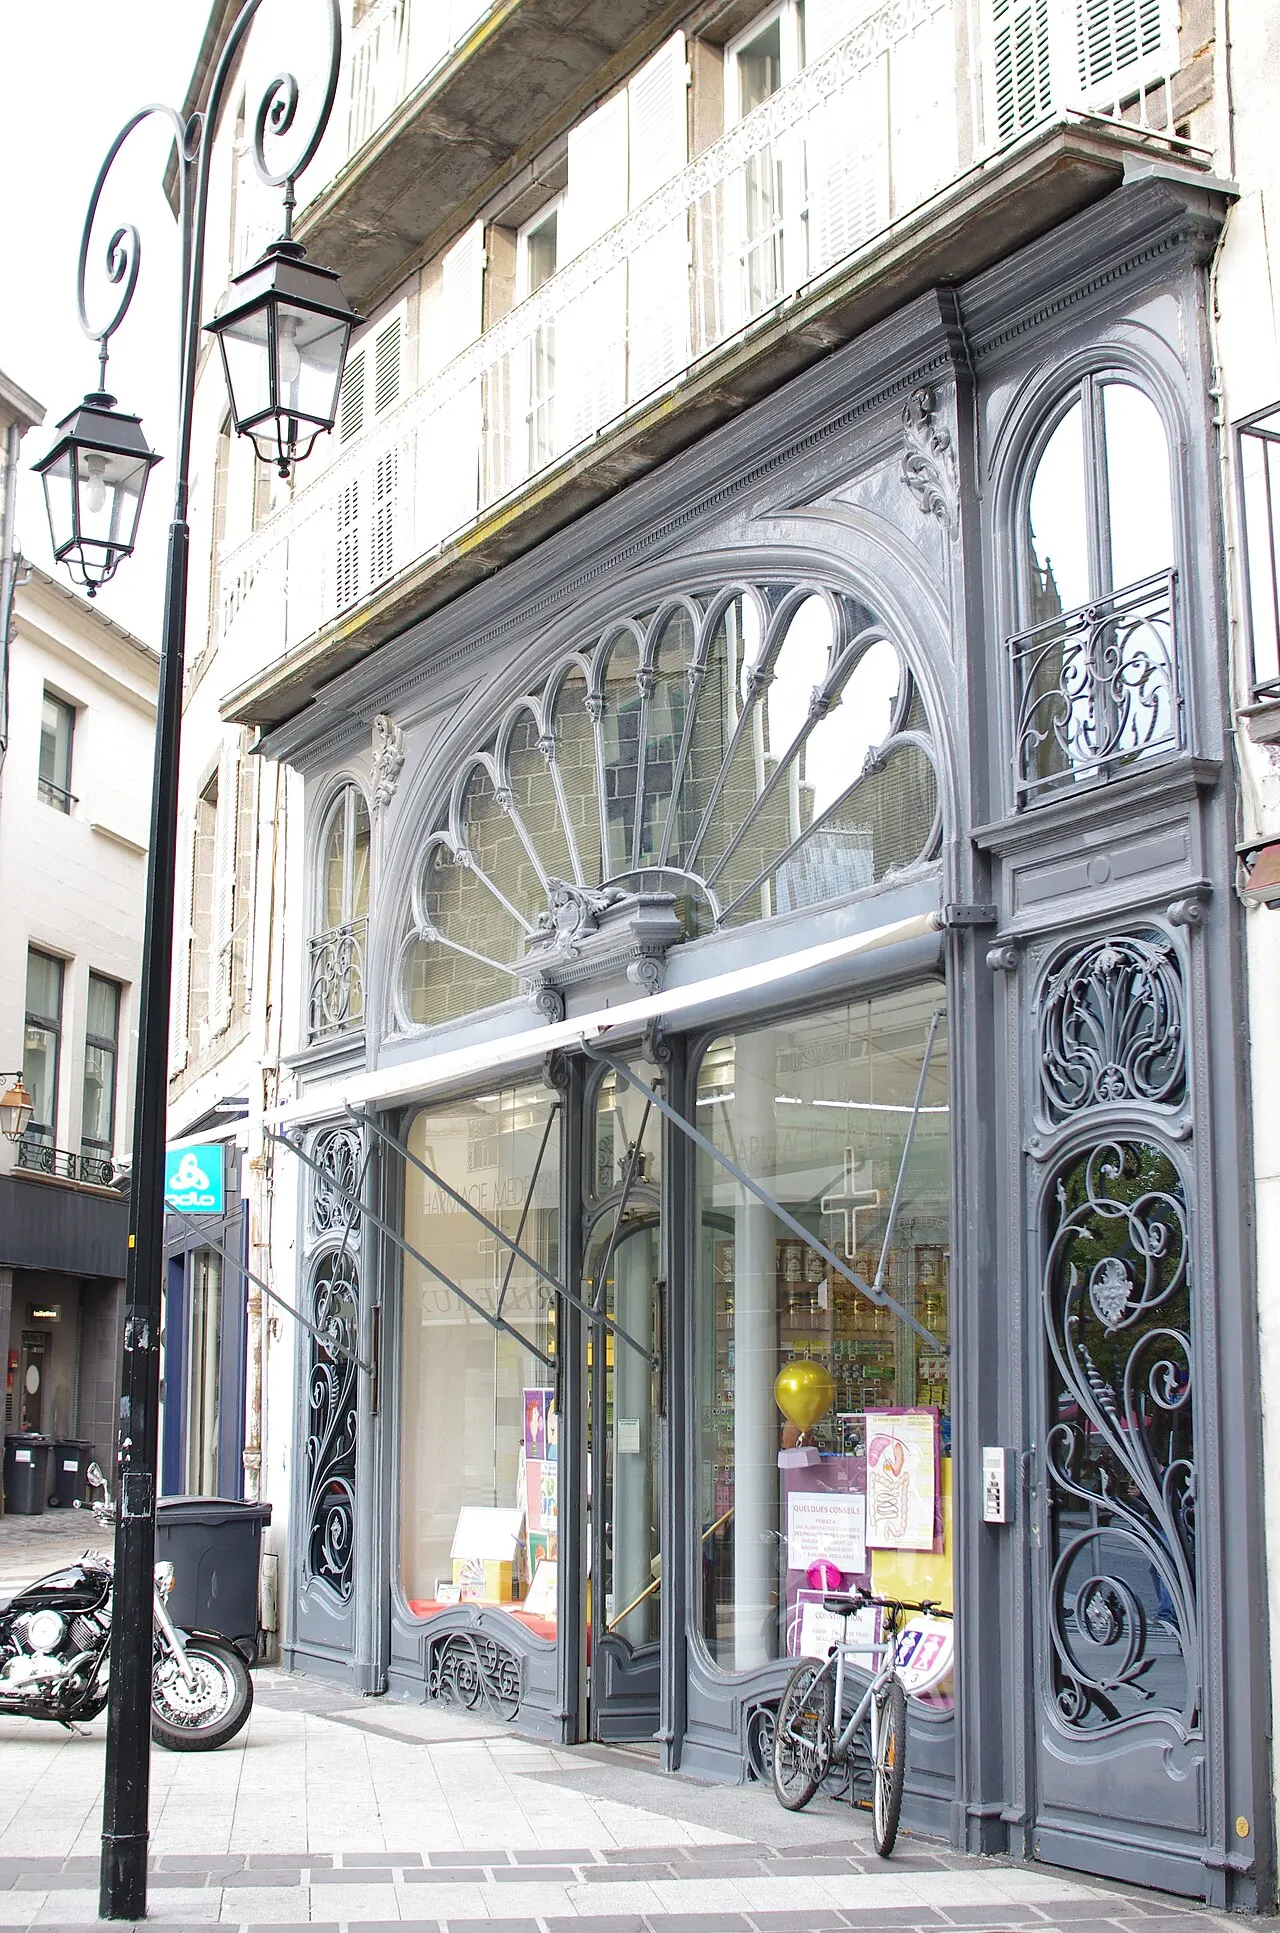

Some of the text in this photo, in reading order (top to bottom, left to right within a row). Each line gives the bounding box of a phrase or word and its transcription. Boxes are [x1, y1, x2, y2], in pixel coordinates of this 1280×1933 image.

[164, 1191, 215, 1206] odlo
[793, 1505, 861, 1515] QUELQUES CONSEILS
[910, 1673, 919, 1683] 3
